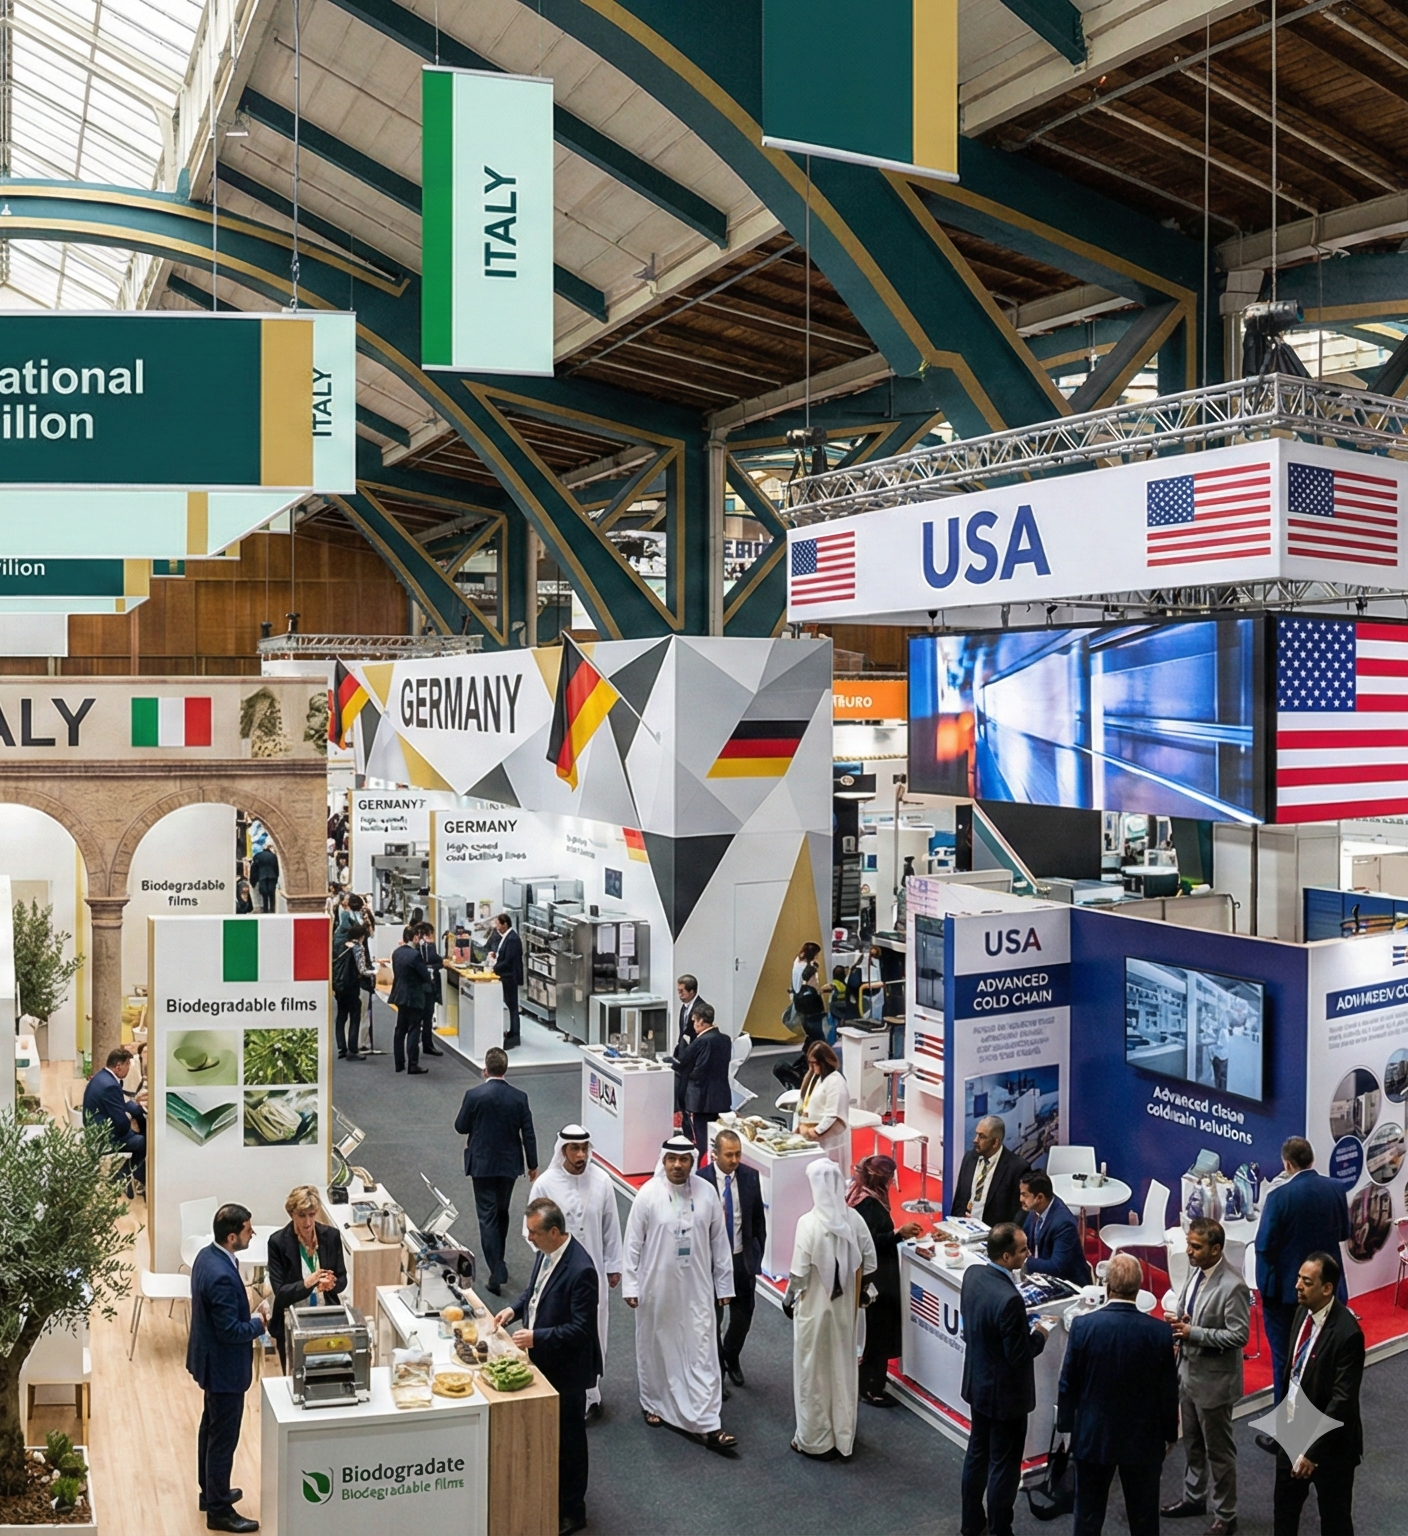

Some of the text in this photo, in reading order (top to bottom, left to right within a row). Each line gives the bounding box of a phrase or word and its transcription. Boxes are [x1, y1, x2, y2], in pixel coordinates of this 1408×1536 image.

[483, 165, 518, 279] ITALY
[312, 367, 333, 437] ITALY
[922, 504, 1052, 590] USA
[400, 673, 523, 734] GERMANY
[444, 820, 518, 833] GERMANY
[168, 895, 199, 907] films
[984, 927, 1042, 957] USA
[976, 973, 1049, 993] ADVANCED
[166, 997, 318, 1017] Biodegradable films
[973, 989, 1052, 1011] COLD CHAIN
